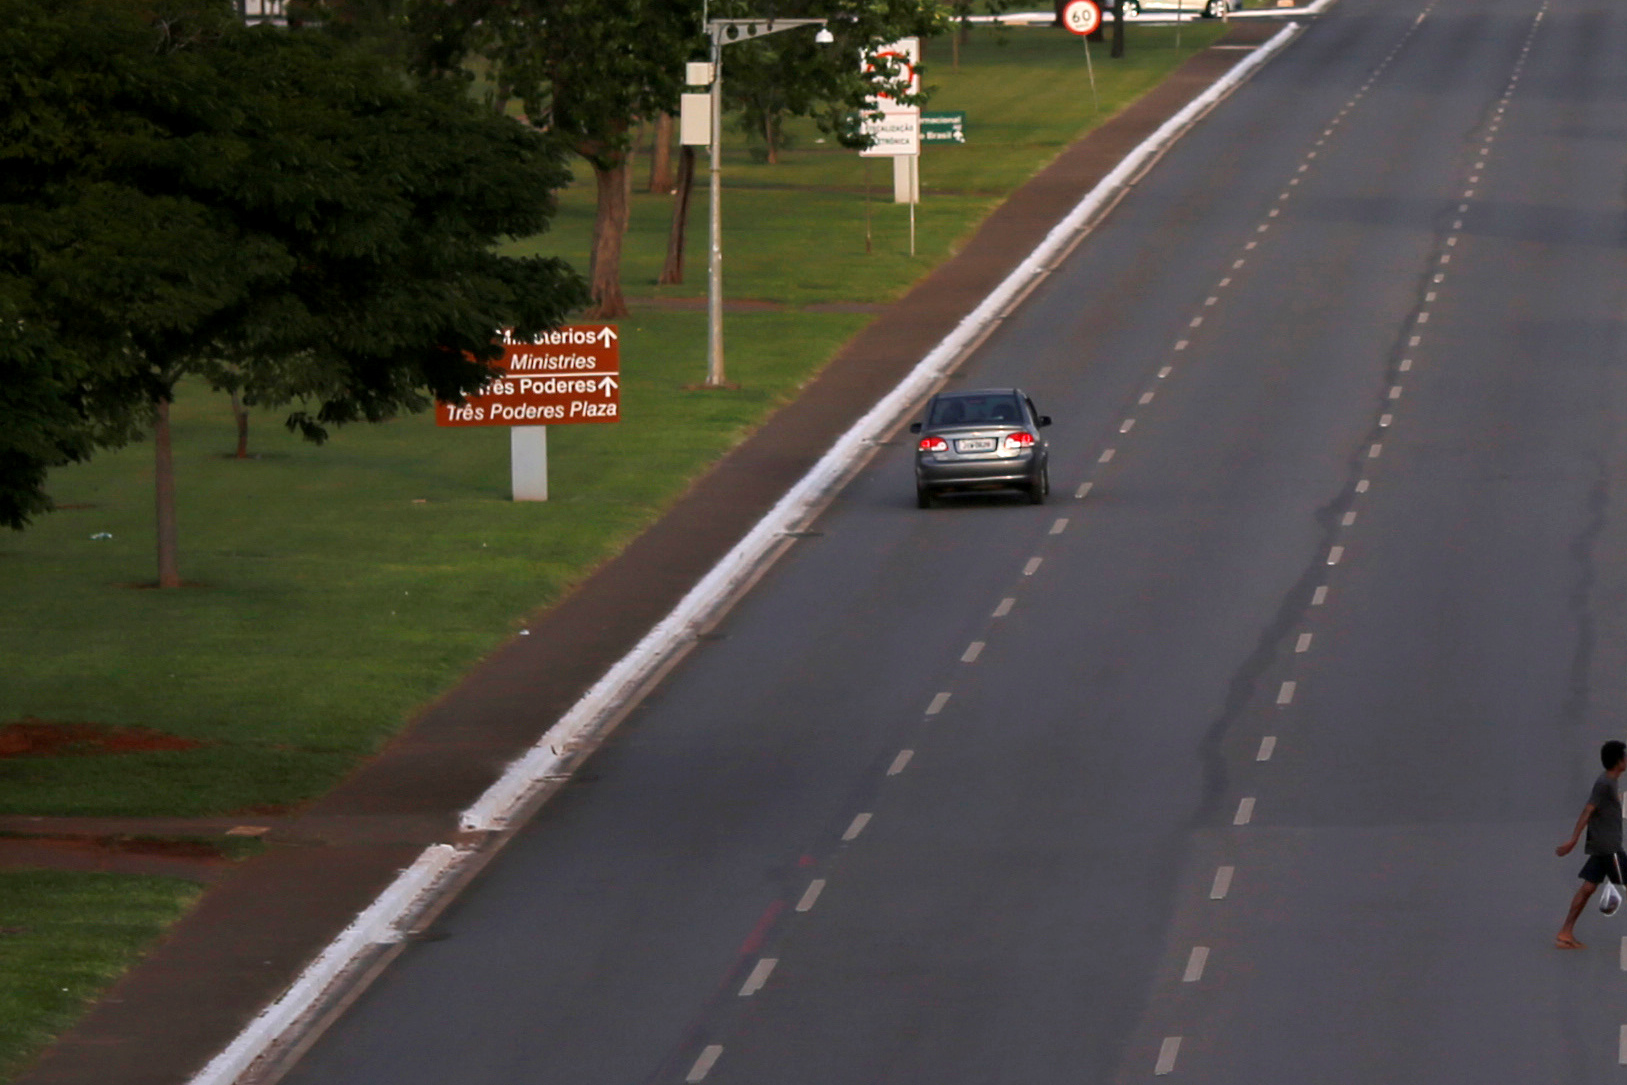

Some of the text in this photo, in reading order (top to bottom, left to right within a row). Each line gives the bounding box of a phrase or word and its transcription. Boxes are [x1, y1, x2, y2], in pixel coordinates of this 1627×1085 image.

[1072, 9, 1092, 23] 60
[510, 354, 596, 370] Ministries
[479, 377, 514, 396] ês
[520, 378, 597, 394] Poderes
[447, 401, 617, 421] Três Poderes Plaza
